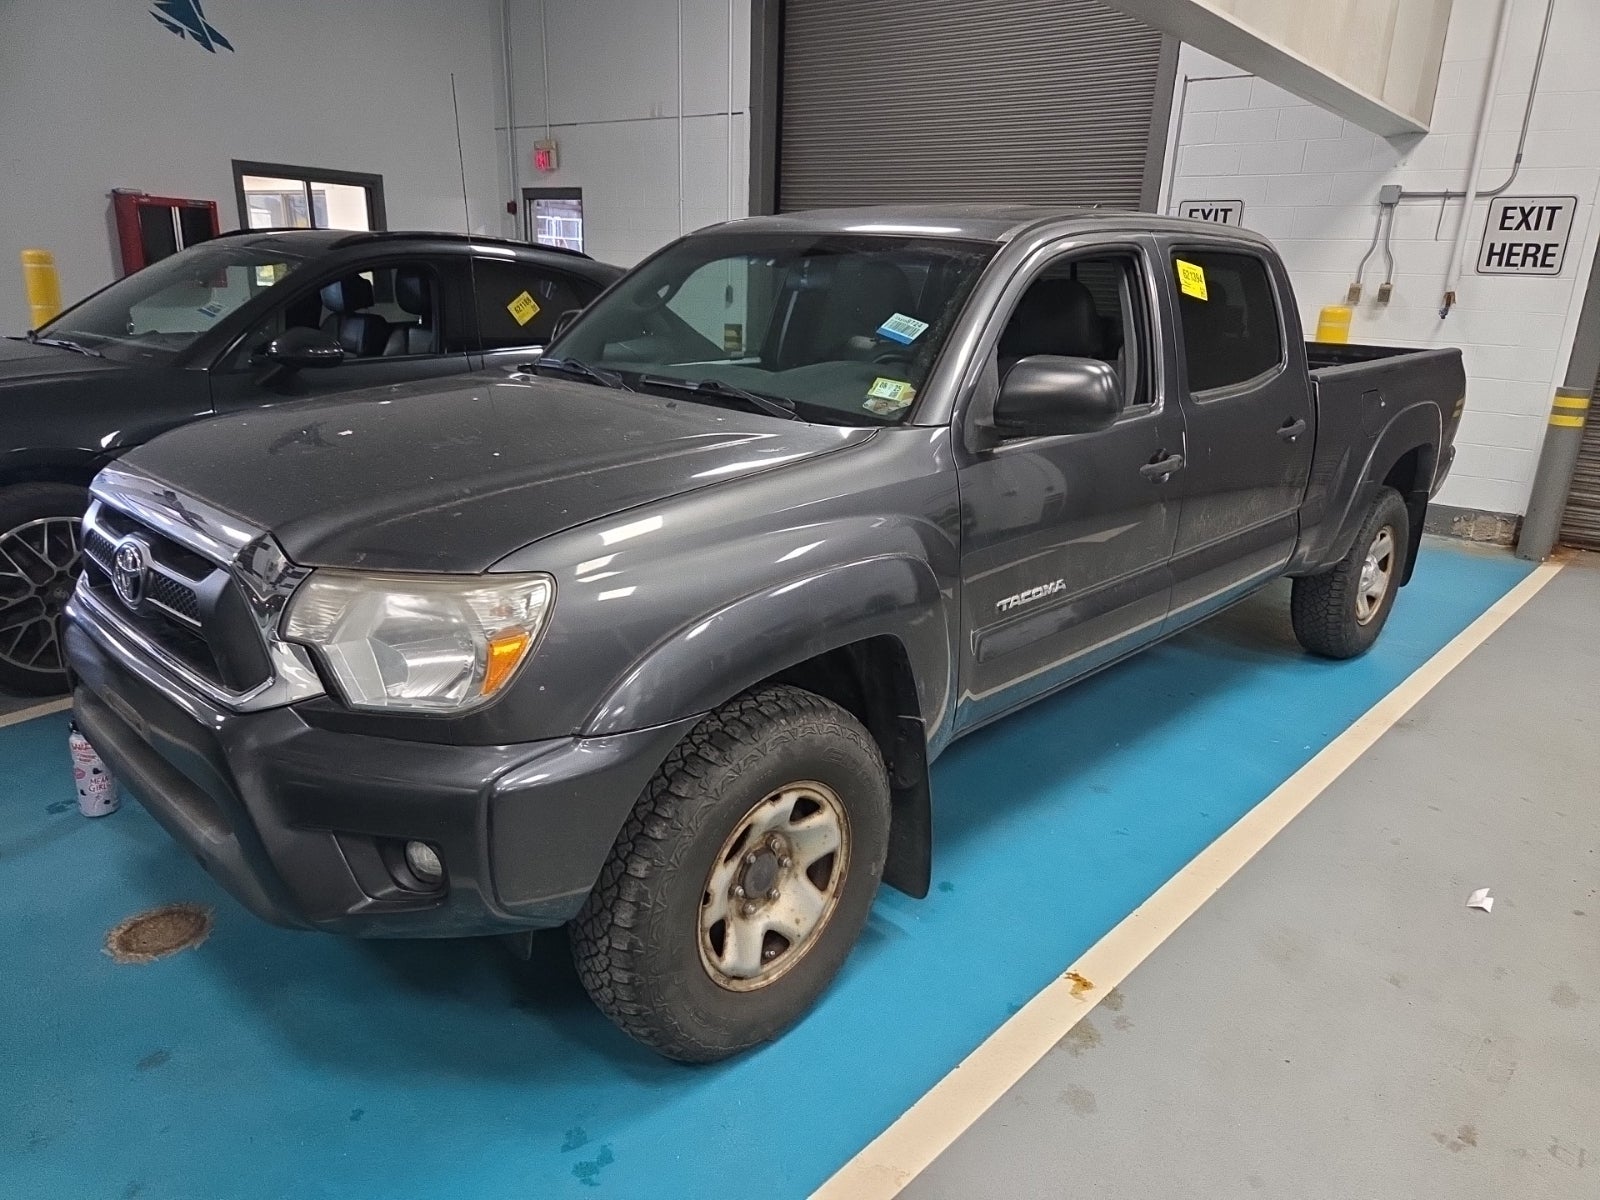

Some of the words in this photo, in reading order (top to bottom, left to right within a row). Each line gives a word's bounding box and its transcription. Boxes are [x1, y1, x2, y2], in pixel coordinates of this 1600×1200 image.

[1499, 206, 1563, 231] EXIT
[1485, 242, 1559, 268] HERE
[996, 579, 1067, 612] TACOMA
